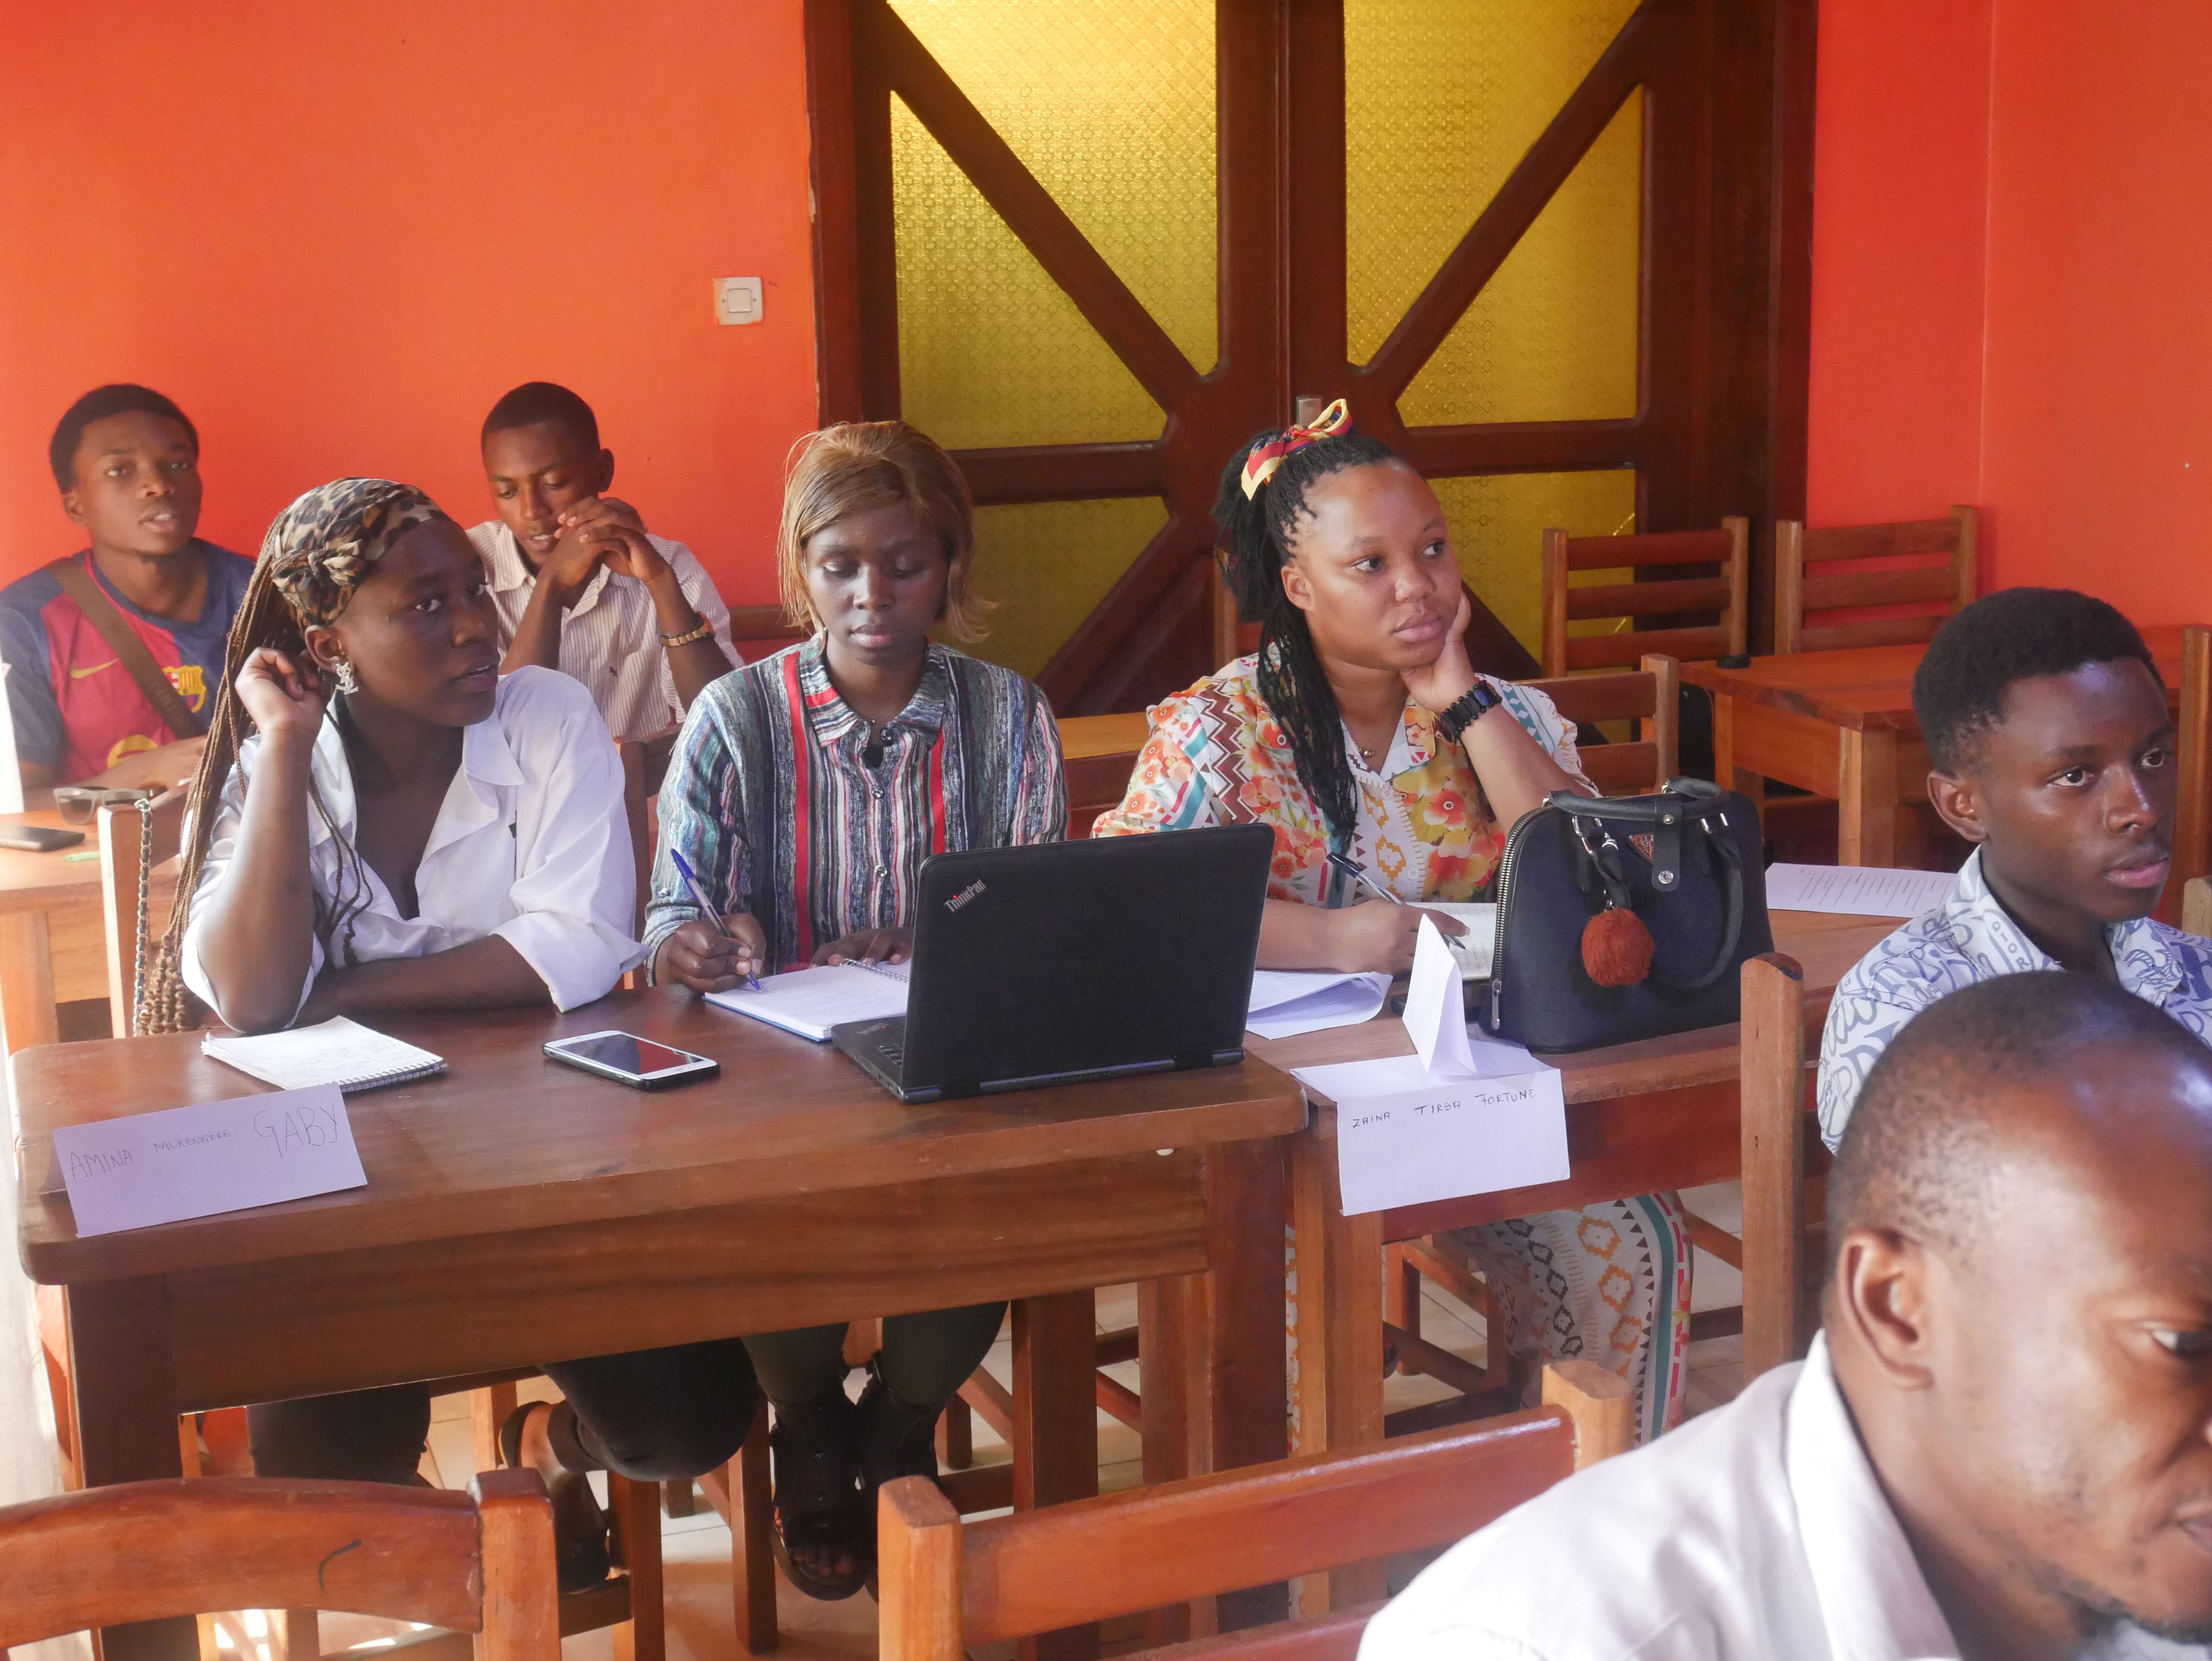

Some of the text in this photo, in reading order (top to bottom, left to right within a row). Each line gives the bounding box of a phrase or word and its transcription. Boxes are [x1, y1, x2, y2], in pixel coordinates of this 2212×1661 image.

[944, 878, 986, 912] ThinkPad
[1991, 921, 2029, 970] DIOR
[1352, 1089, 1537, 1128] ZAINA TIRSA FORTUNE
[69, 1149, 133, 1183] AMINA
[253, 1105, 338, 1158] GABY
